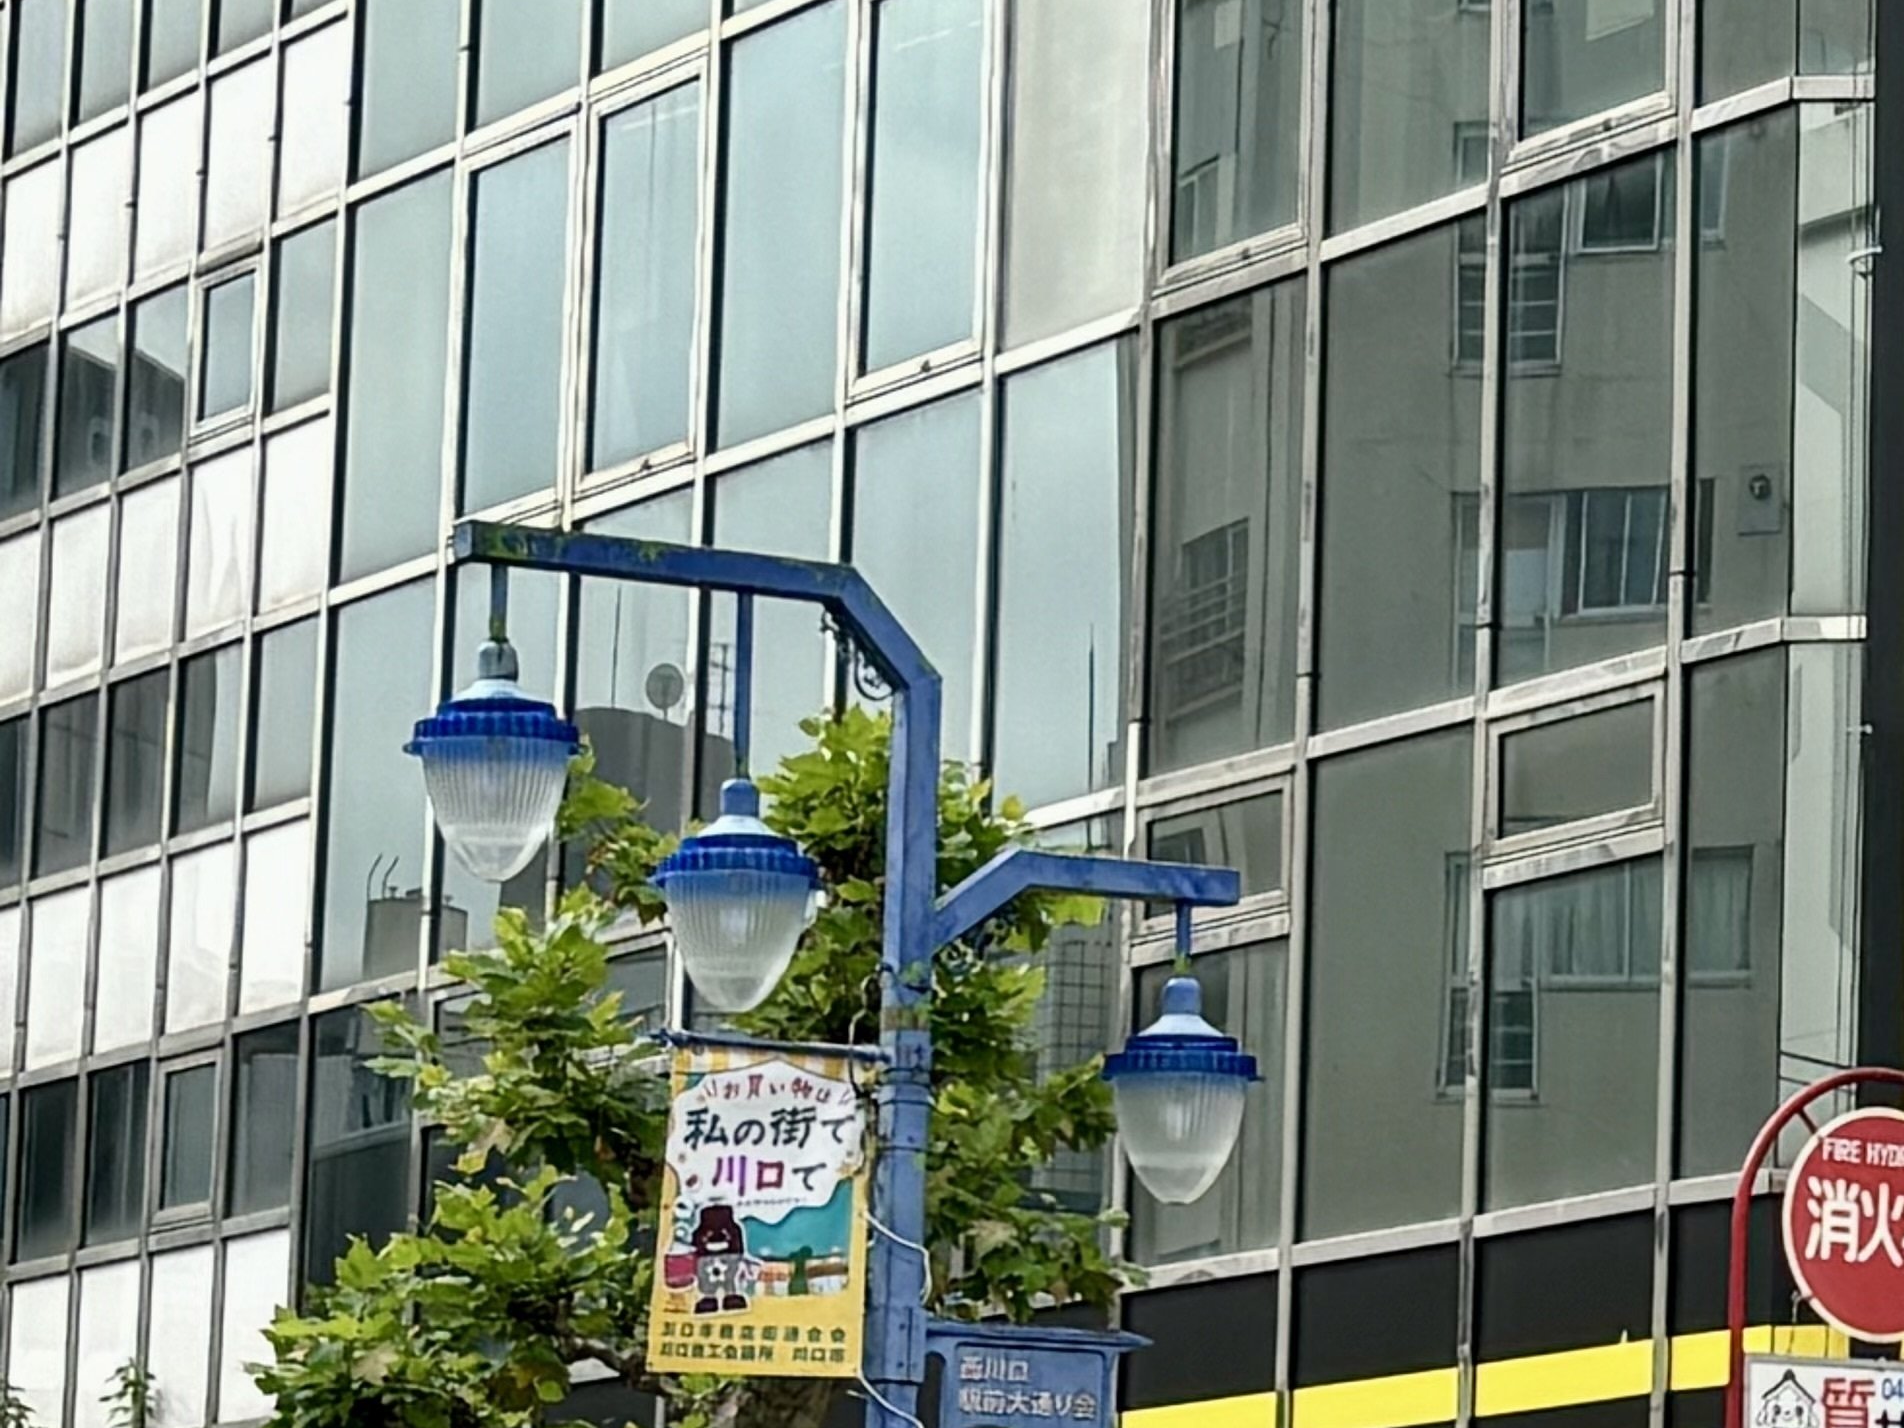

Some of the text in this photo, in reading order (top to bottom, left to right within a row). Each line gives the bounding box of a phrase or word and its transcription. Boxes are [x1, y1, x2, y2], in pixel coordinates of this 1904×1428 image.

[1822, 1138, 1862, 1164] FIRE
[960, 1356, 1029, 1381] 西川口
